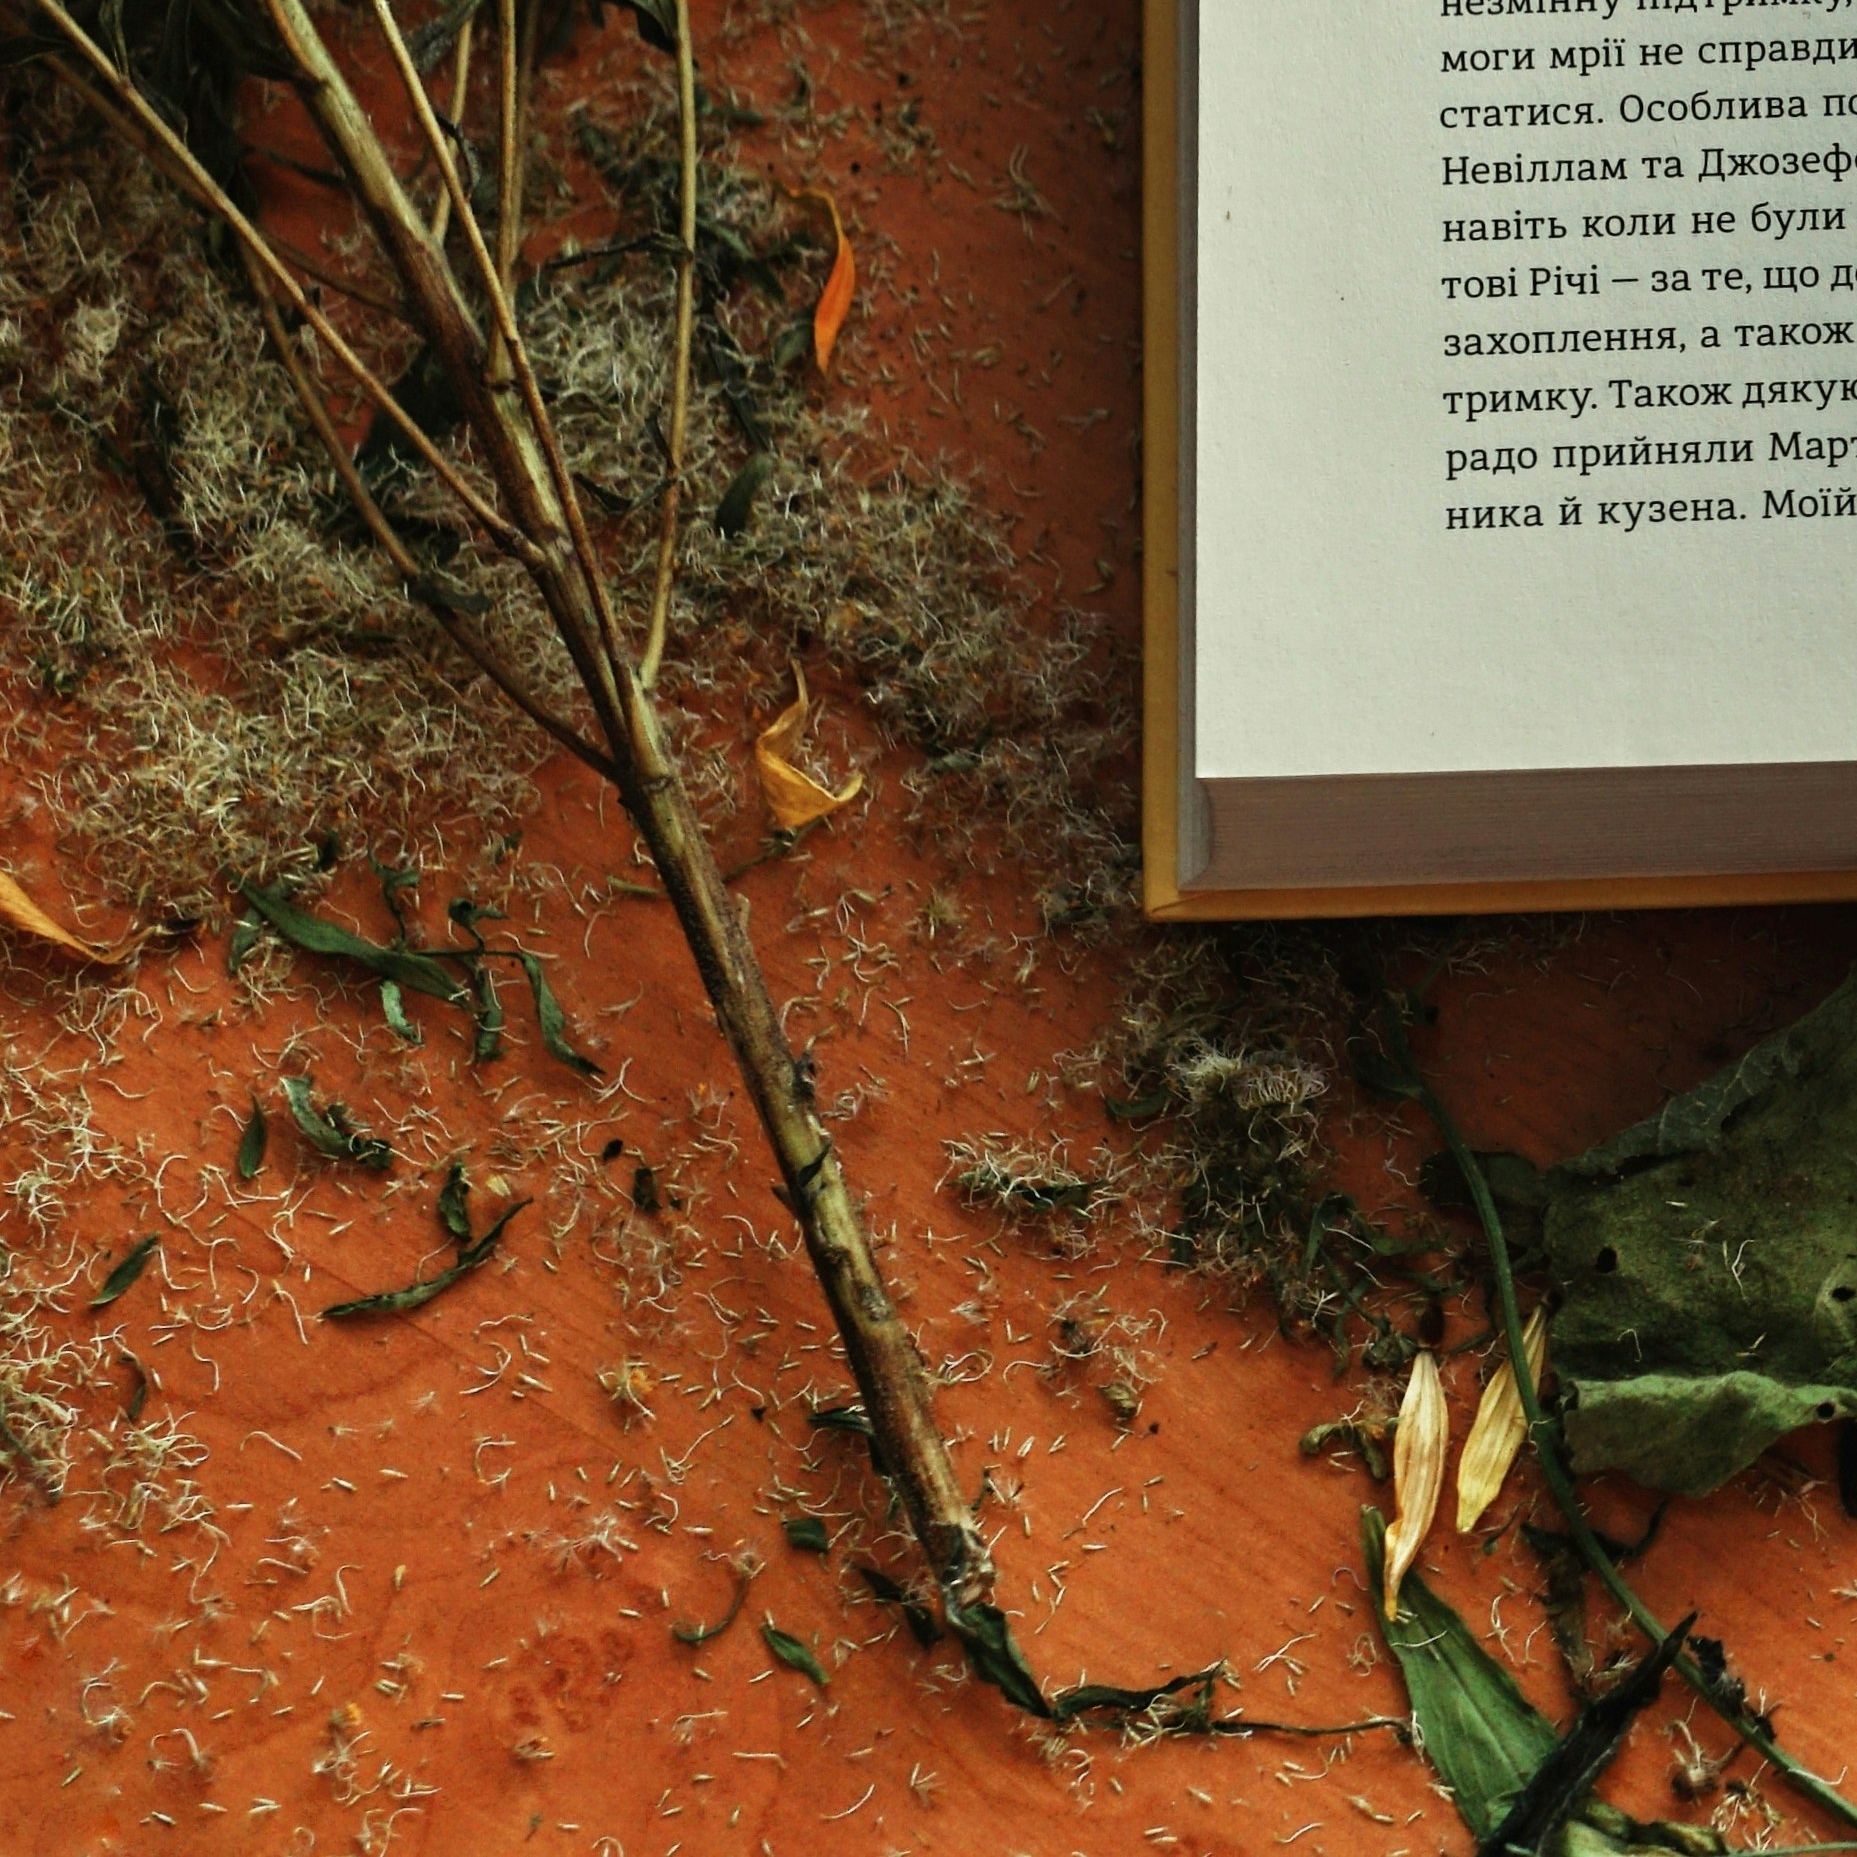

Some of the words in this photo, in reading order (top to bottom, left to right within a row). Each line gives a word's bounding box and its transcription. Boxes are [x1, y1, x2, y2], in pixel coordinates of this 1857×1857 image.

[1441, 152, 1629, 187] Невіллам
[1640, 155, 1686, 180] та
[1445, 446, 1539, 482] радо
[1552, 435, 1755, 477] прийняли
[1445, 503, 1545, 531] ника
[1558, 495, 1583, 527] й
[1596, 497, 1747, 534] кузена.
[1761, 486, 1857, 520] Моїй
